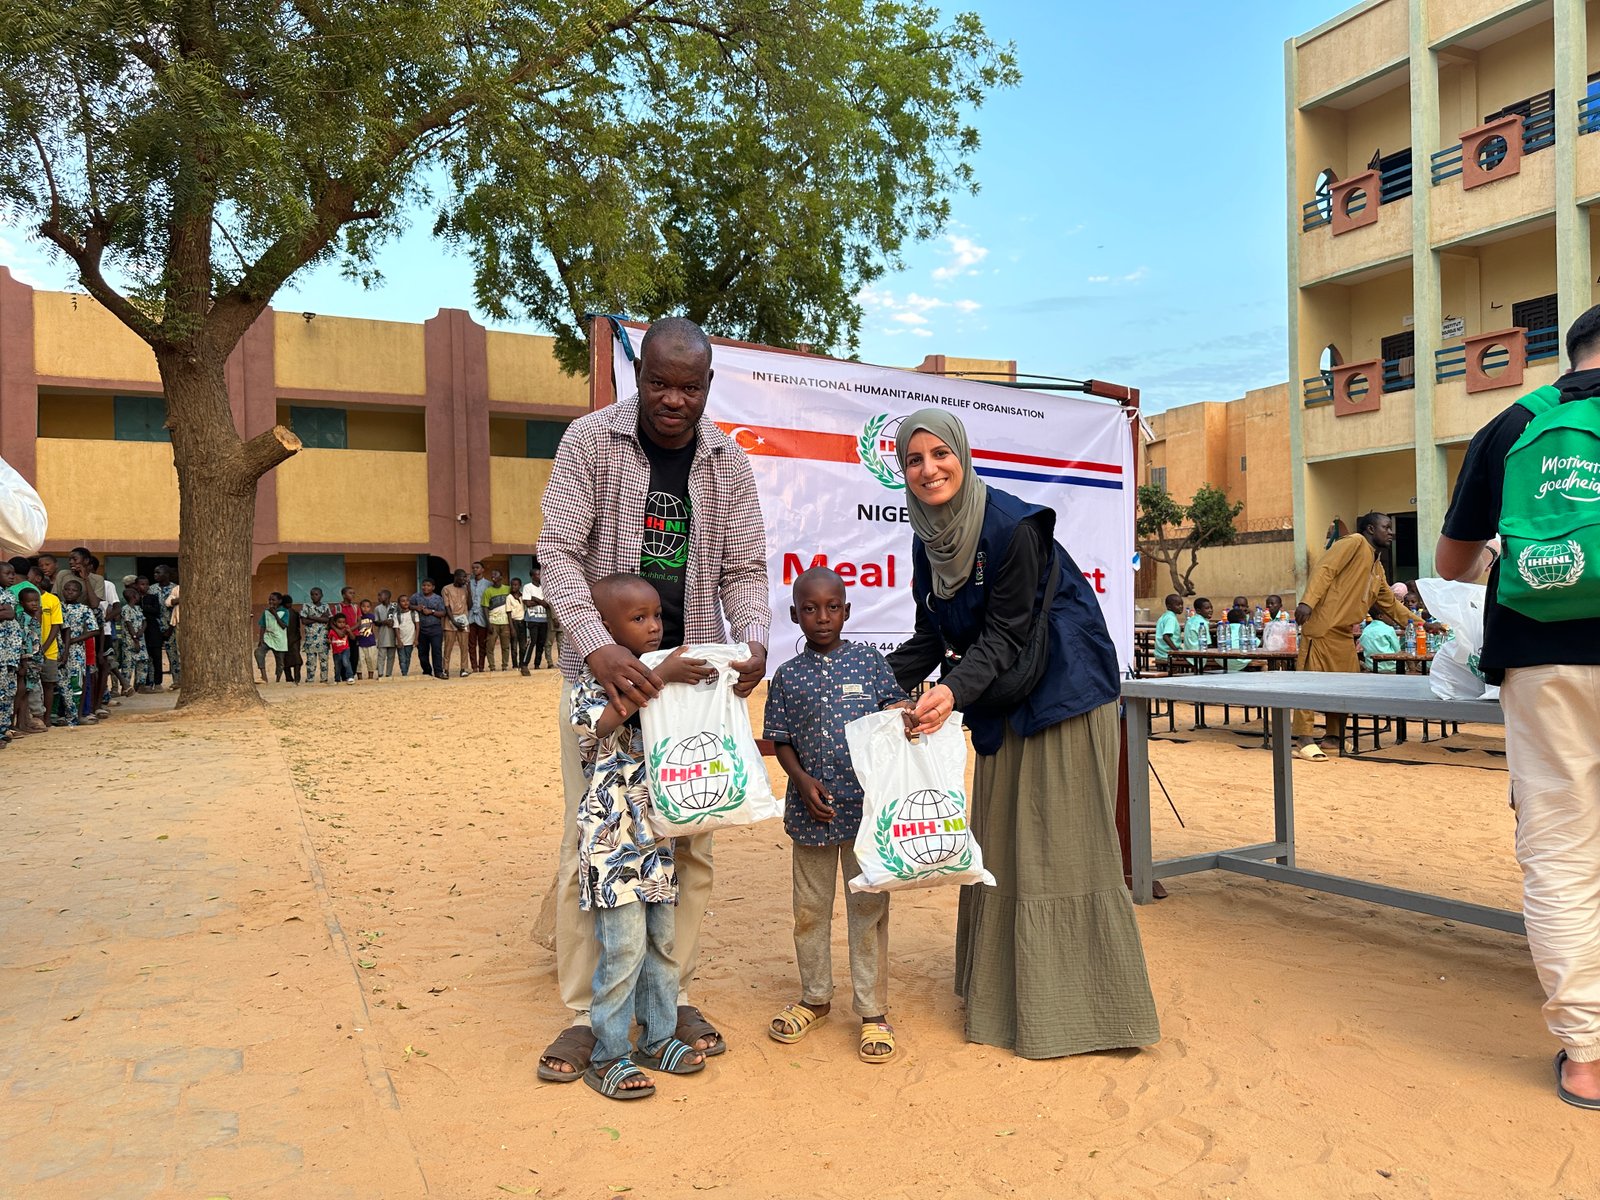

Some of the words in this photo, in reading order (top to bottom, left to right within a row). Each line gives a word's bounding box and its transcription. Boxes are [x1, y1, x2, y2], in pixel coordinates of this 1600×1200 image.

[752, 371, 852, 392] INTERNATIONAL
[854, 384, 939, 404] HUMANITARIAN
[941, 396, 971, 408] RELIEF
[972, 401, 1045, 419] ORGANISATION
[1541, 455, 1600, 475] Motivat
[857, 504, 910, 523] NIGE
[783, 552, 896, 587] Meal
[1527, 555, 1572, 567] IHHNL
[879, 642, 894, 651] 44
